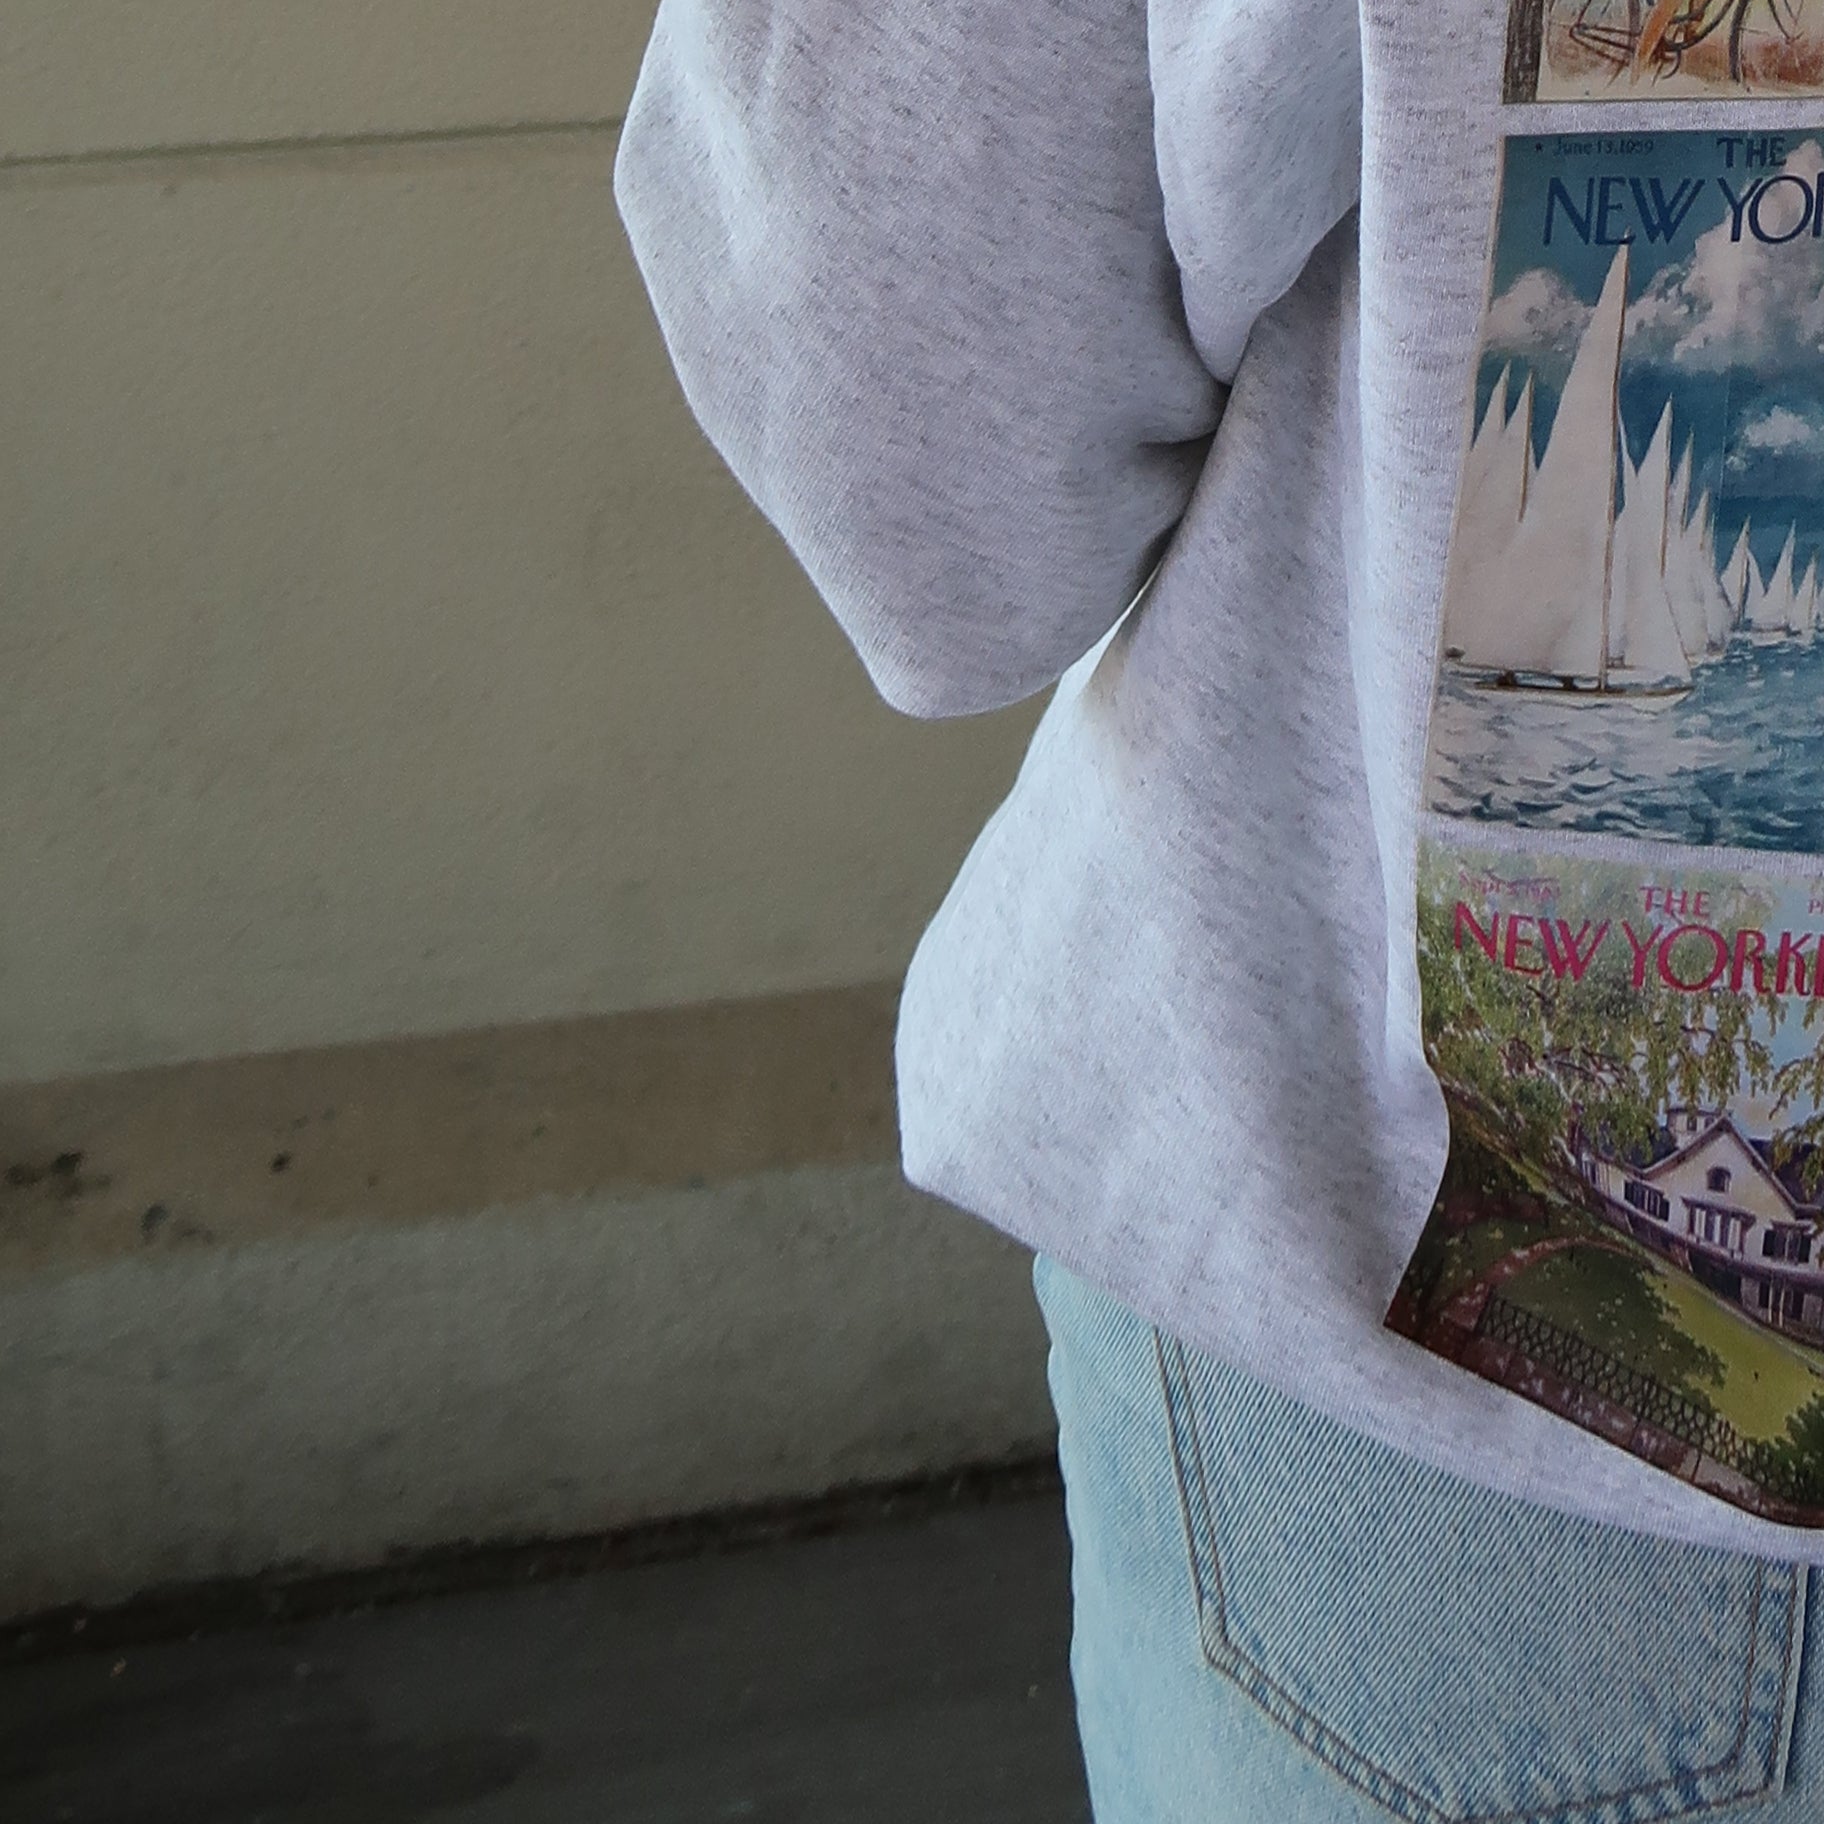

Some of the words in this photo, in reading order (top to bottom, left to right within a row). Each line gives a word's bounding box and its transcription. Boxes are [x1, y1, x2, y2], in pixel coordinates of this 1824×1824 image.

[1717, 136, 1786, 169] THE
[1543, 176, 1704, 246] NEW
[1638, 886, 1711, 918] THE
[1453, 901, 1611, 982] NEW
